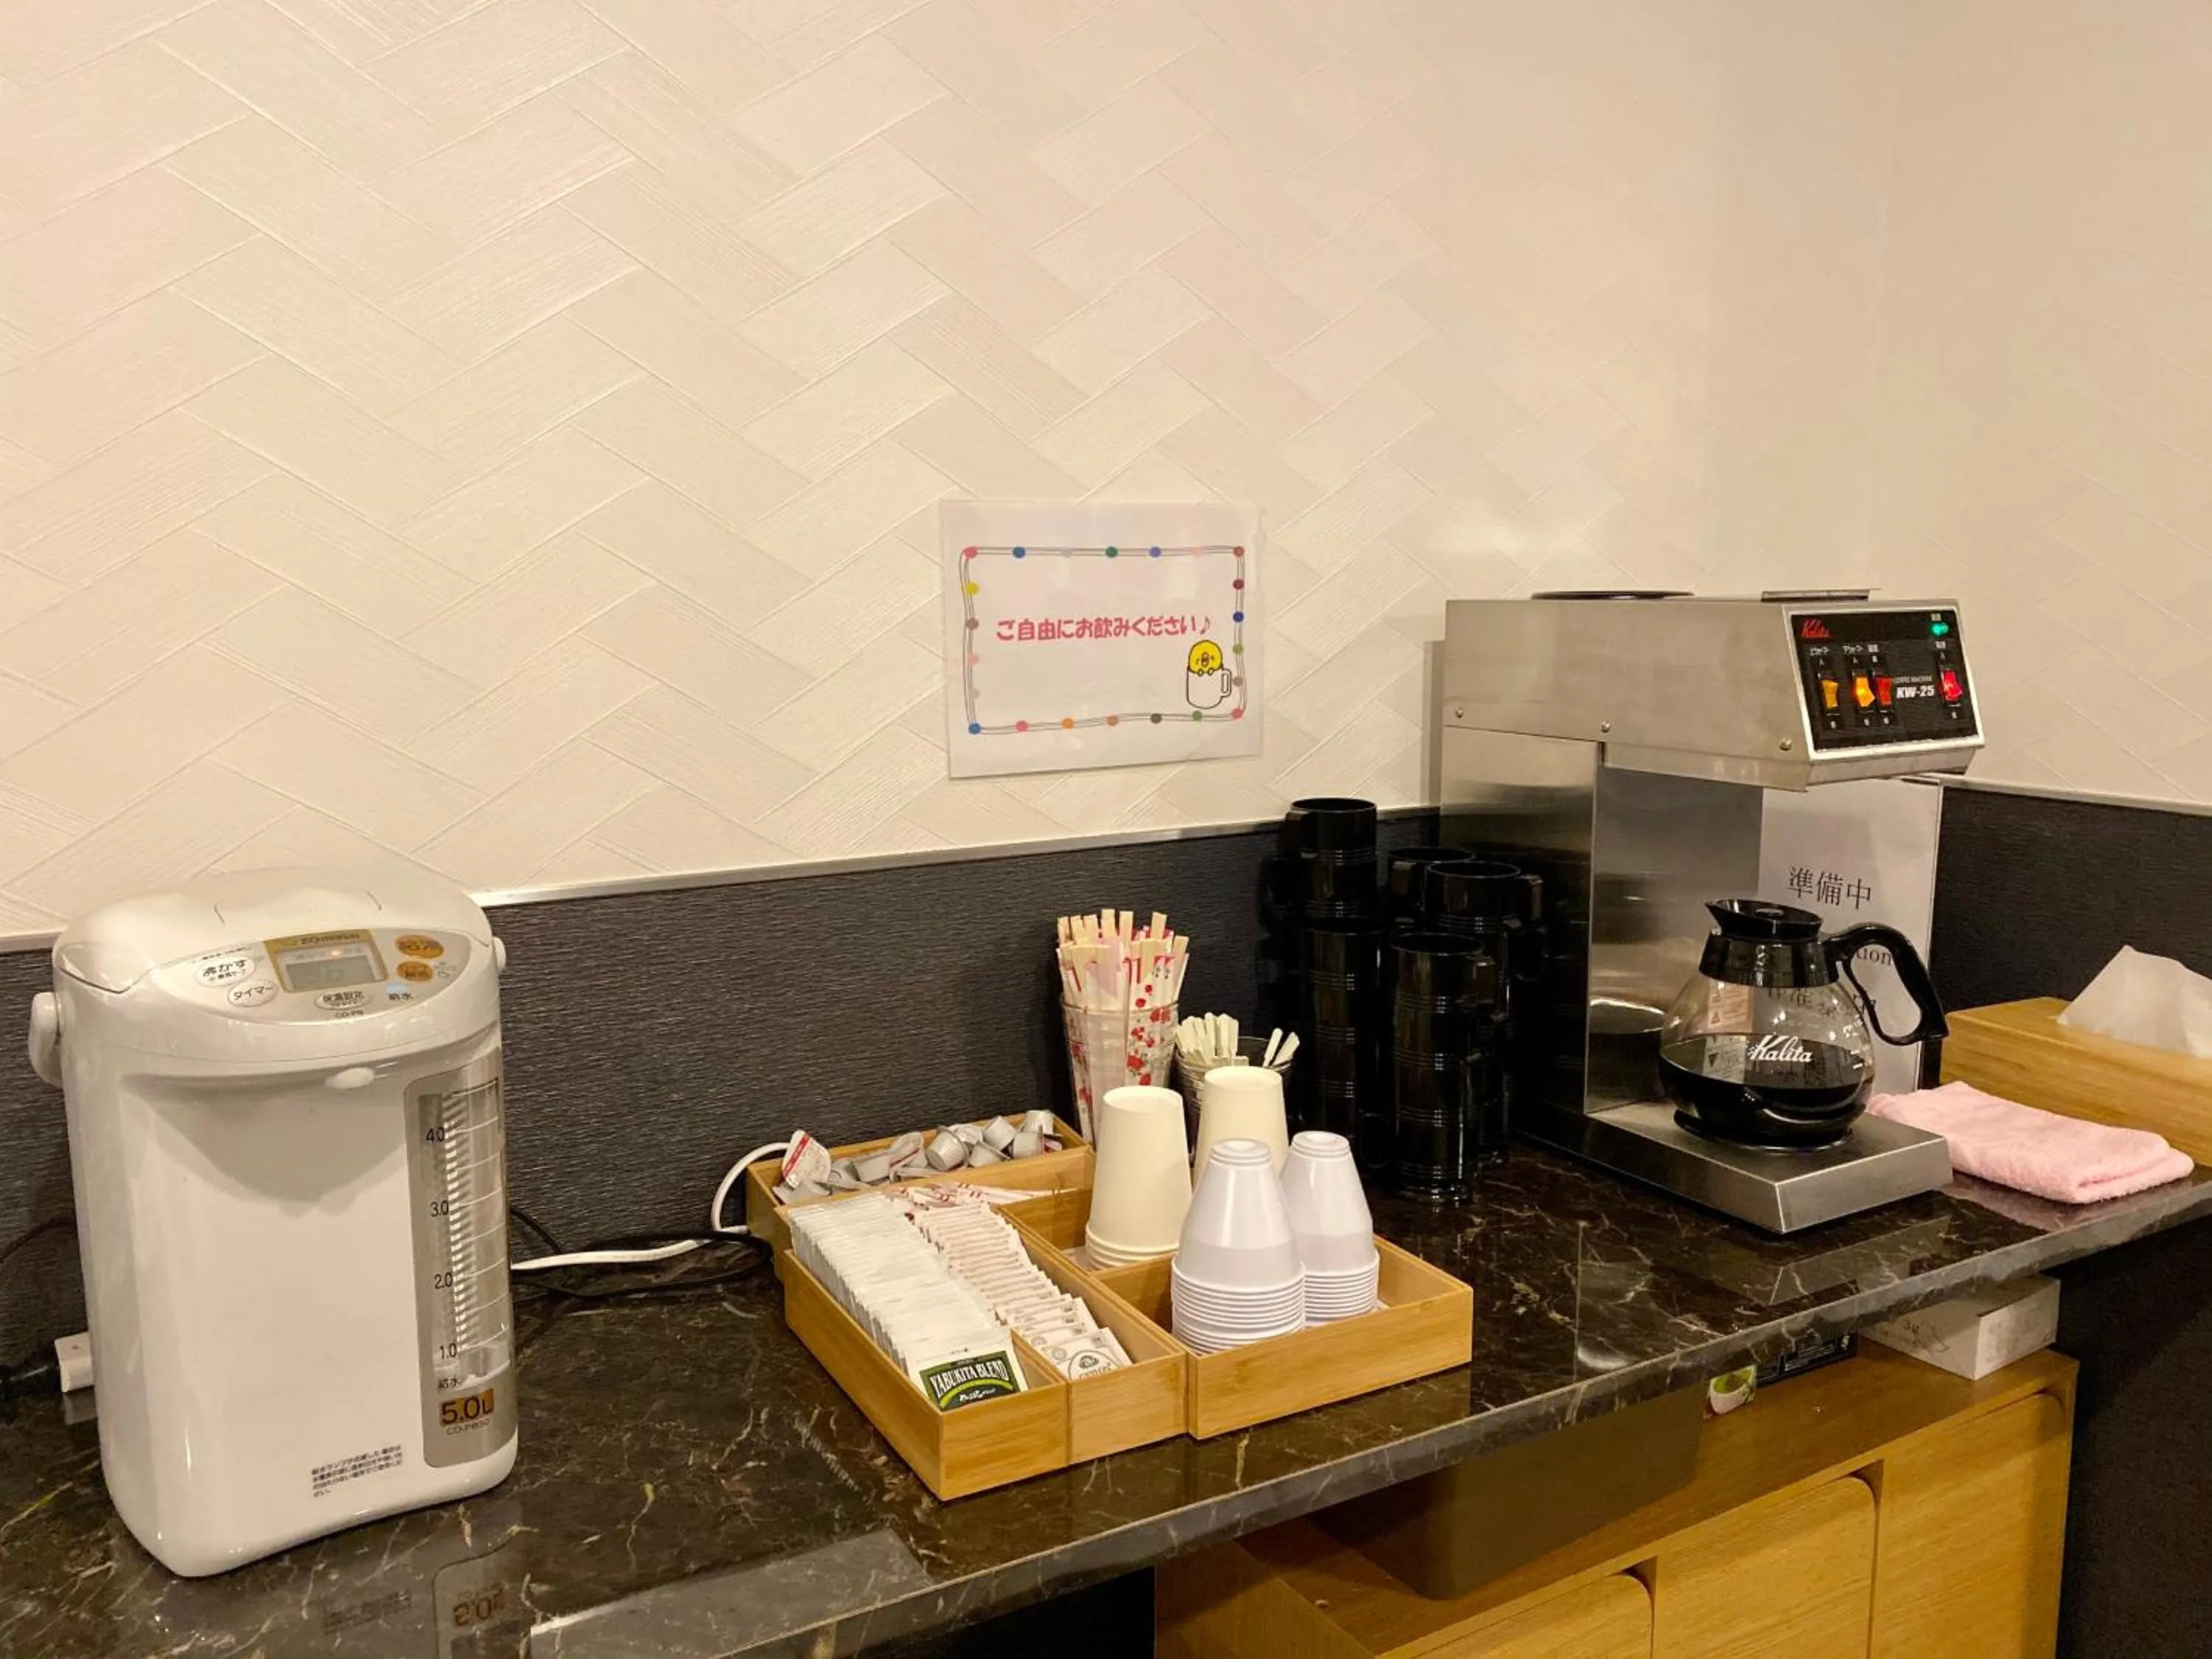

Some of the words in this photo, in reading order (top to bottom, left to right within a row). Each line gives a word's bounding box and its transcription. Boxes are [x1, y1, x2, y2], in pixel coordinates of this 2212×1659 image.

[1896, 684, 1935, 699] KW-25
[1787, 863, 1871, 910] 準備中
[1750, 1034, 1813, 1062] Kalita
[425, 1126, 445, 1143] 4.0
[430, 1200, 449, 1217] 3.0
[434, 1272, 453, 1290] 2.0
[439, 1343, 456, 1360] 1.0
[975, 1359, 1010, 1382] BLEND
[441, 1395, 493, 1425] 5.0L
